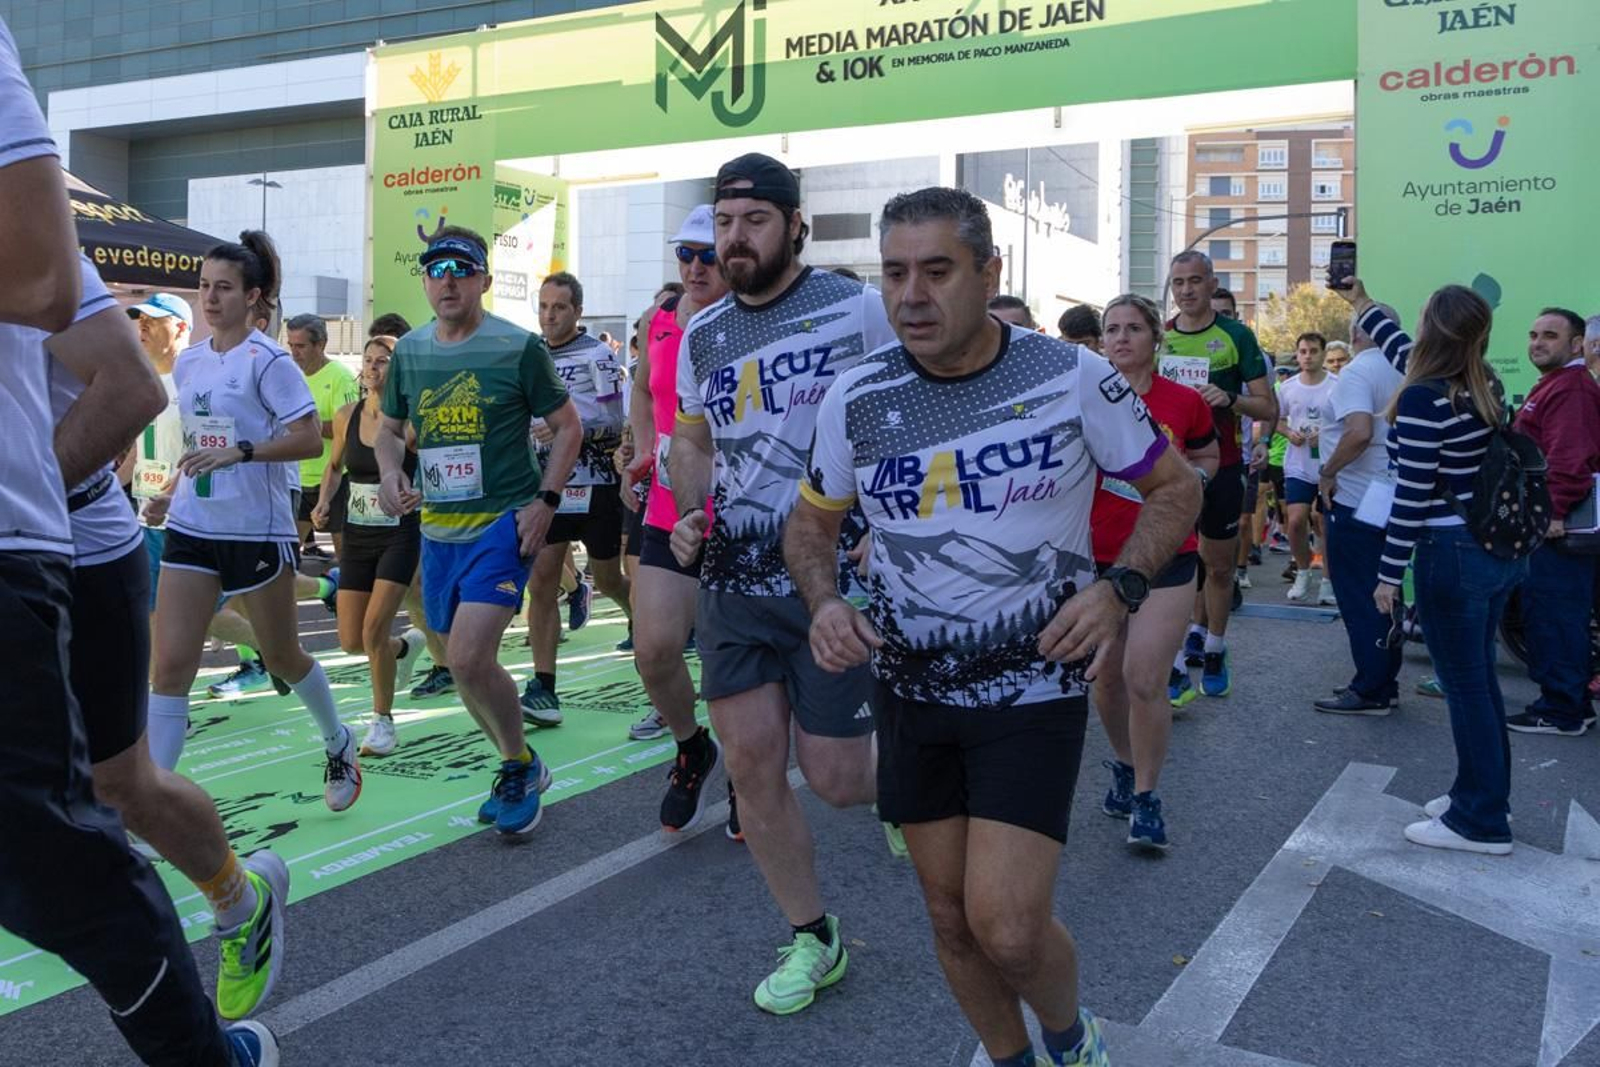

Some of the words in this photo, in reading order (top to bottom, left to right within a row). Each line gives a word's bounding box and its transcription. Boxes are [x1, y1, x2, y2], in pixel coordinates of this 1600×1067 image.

[1437, 2, 1517, 35] JAÉN
[785, 30, 857, 59] MEDIA
[866, 9, 988, 50] MARATÓN
[1000, 8, 1033, 34] DE
[891, 58, 905, 68] EN
[907, 51, 955, 67] MEMORIA
[957, 49, 972, 62] DE
[973, 46, 1002, 60] PACO
[1004, 37, 1070, 56] MANZANEDA
[815, 61, 837, 84] &
[1378, 52, 1576, 92] calderón
[1420, 90, 1460, 103] obras
[1463, 84, 1531, 100] maestras
[387, 111, 425, 131] CAJA
[428, 104, 483, 126] RURAL
[413, 127, 454, 150] JAÉN
[383, 163, 481, 189] calderón
[1401, 175, 1557, 202] Ayuntamiento
[403, 187, 424, 197] obras
[425, 184, 458, 195] maestras
[1434, 200, 1462, 217] de
[1466, 195, 1522, 216] Jaén
[94, 245, 204, 274] evedepor
[1180, 368, 1208, 379] 1110
[200, 435, 227, 449] 893
[143, 471, 164, 484] 939
[445, 462, 475, 477] 715
[861, 433, 1063, 496] JABALCUZ
[565, 488, 587, 499] 946
[874, 481, 997, 521] TRAIL
[993, 476, 1062, 522] Jaén
[309, 831, 435, 879] TEAMERGY
